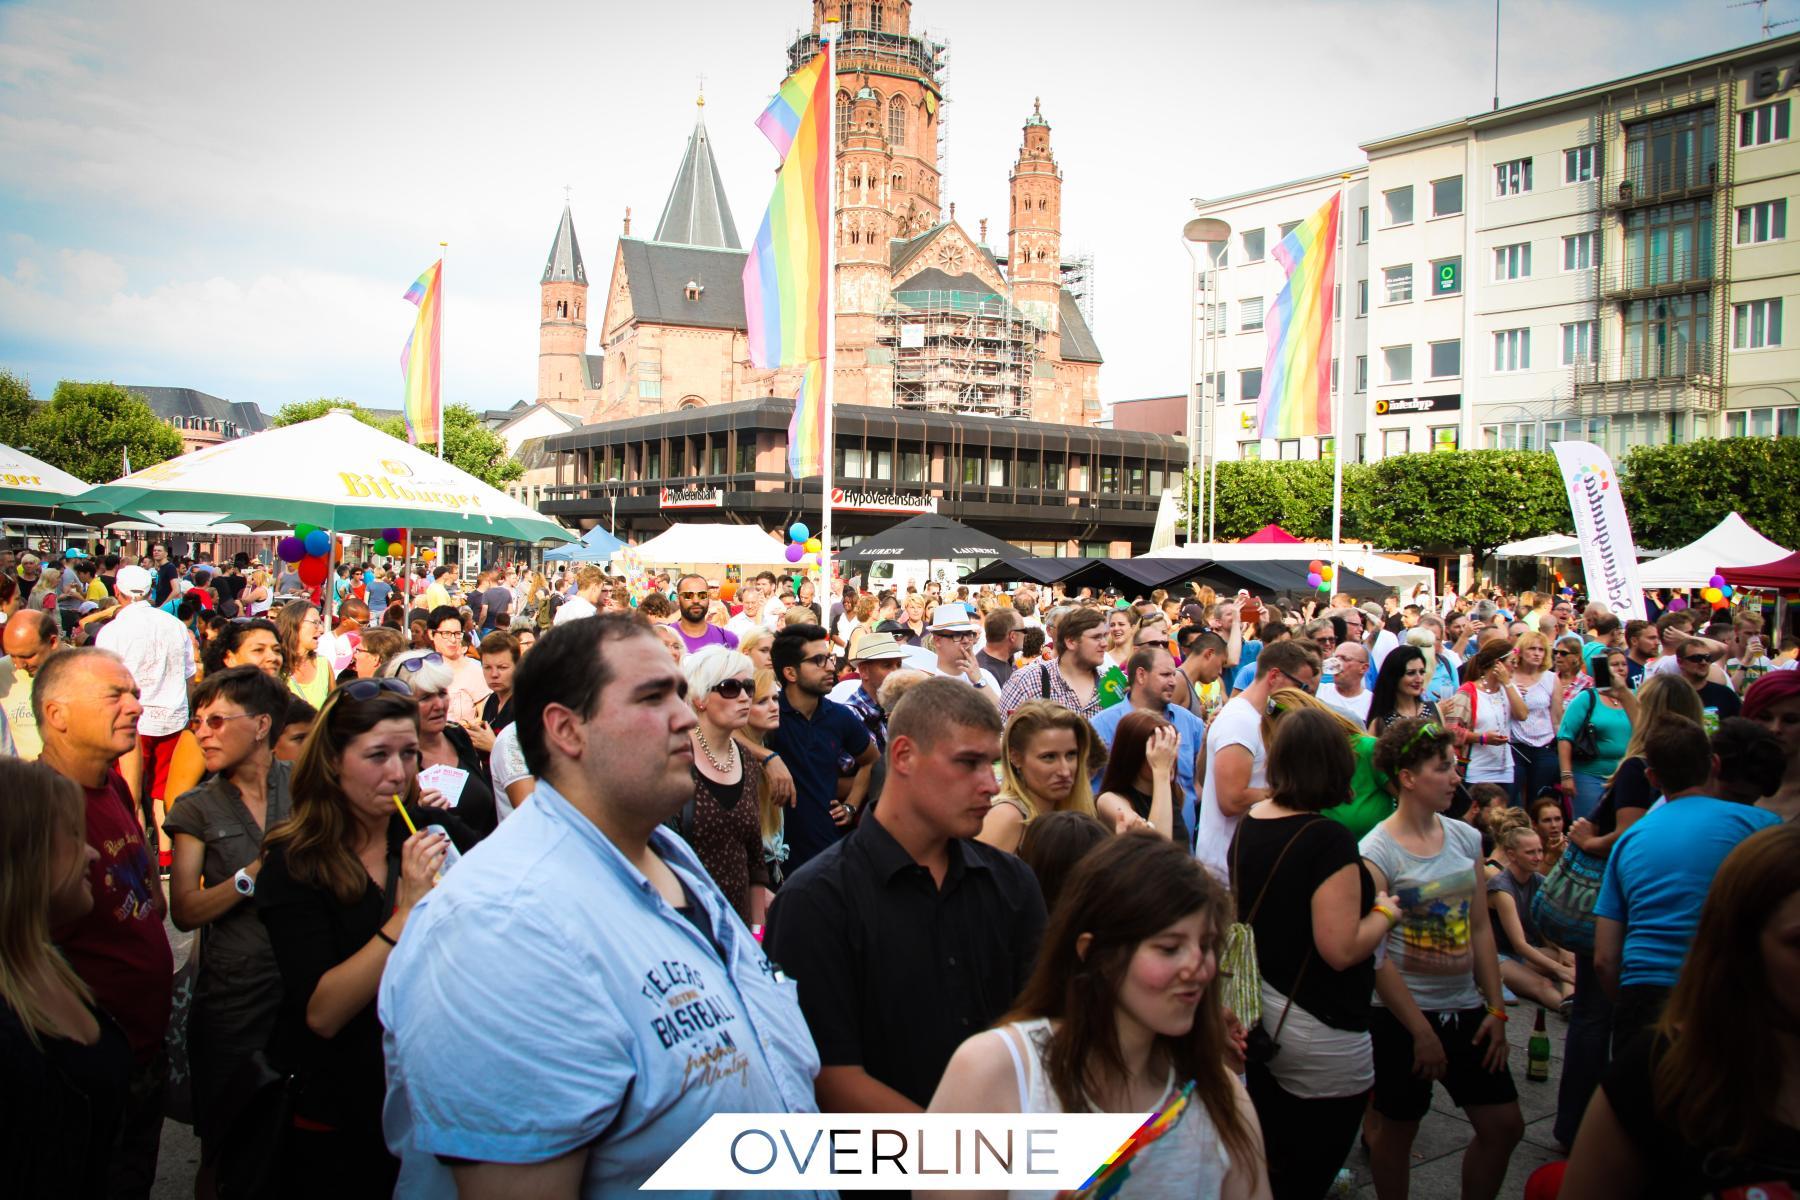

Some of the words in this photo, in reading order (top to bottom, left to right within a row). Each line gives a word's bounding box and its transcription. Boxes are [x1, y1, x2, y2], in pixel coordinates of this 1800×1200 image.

[338, 472, 481, 509] Bitburger
[667, 487, 717, 504] HypoVereinsbank
[844, 490, 933, 507] HypoVereinsbank
[952, 547, 1000, 555] LAURENZ
[650, 995, 735, 1050] BASEBALL
